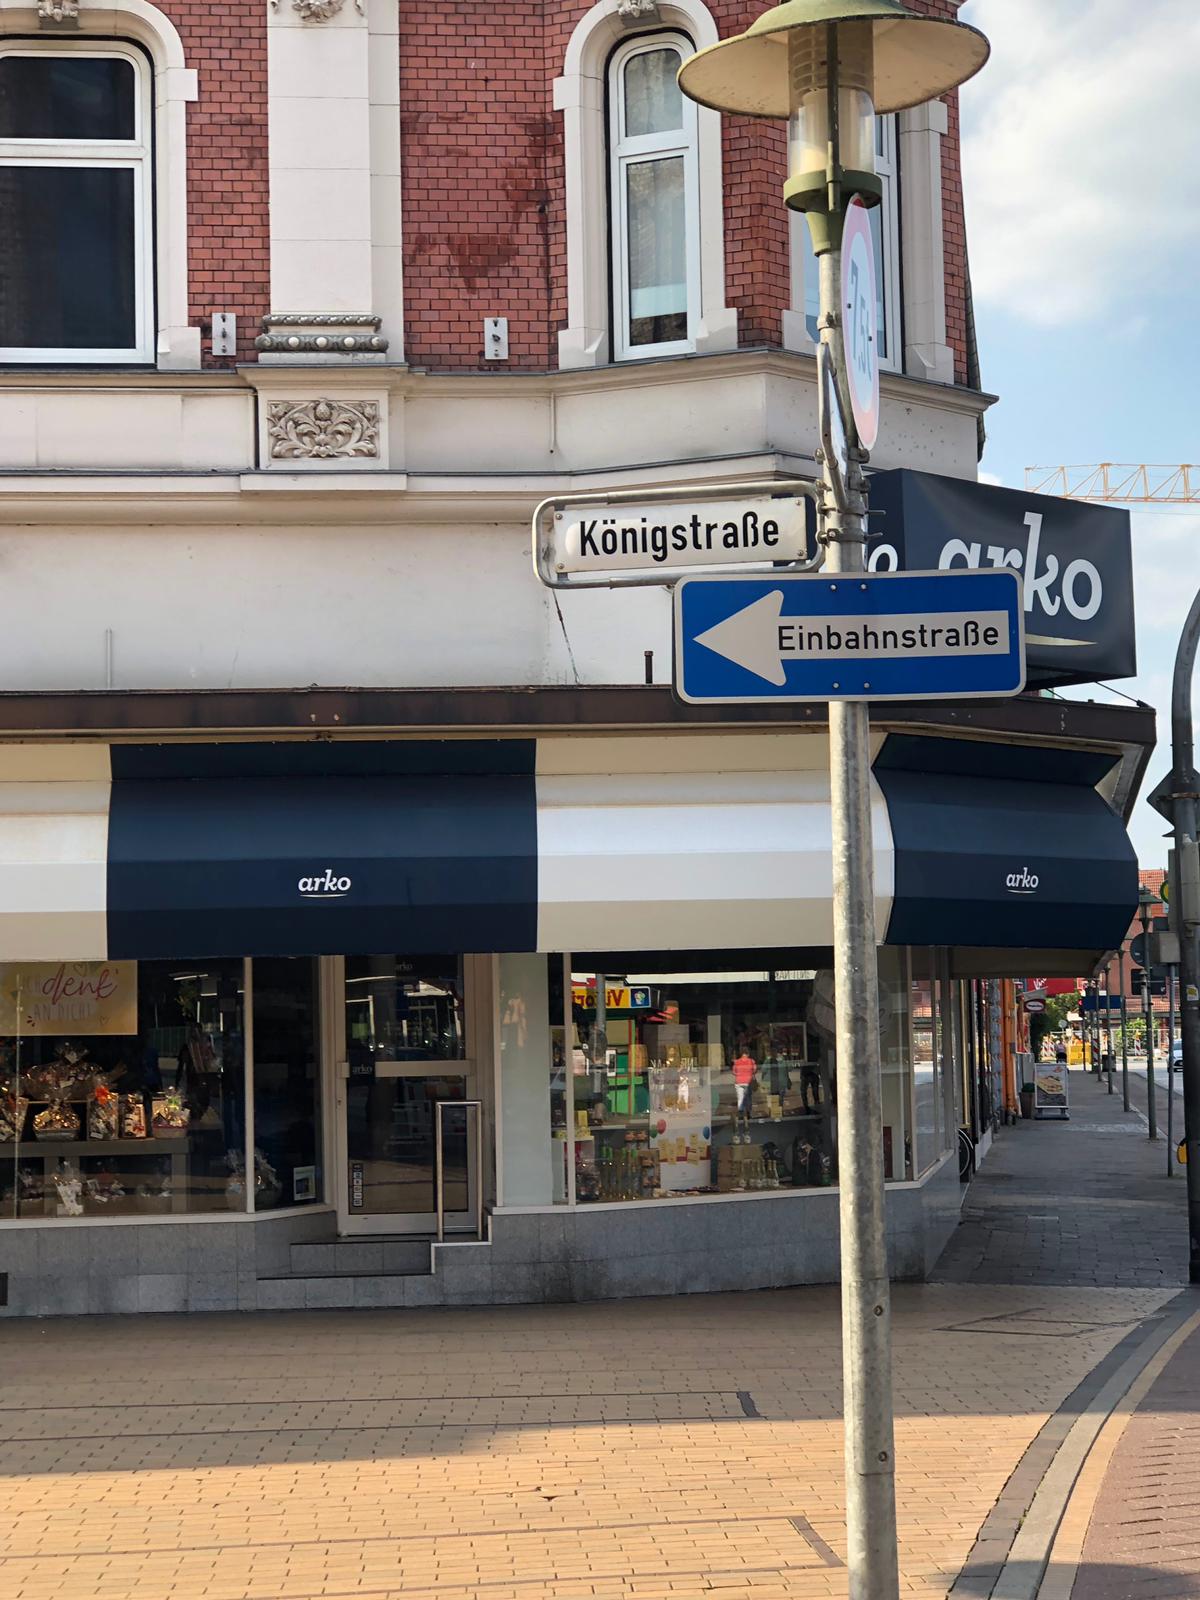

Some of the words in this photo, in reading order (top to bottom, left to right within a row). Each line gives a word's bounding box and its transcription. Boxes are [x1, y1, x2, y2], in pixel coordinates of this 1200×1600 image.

[579, 511, 780, 562] Königstraße
[778, 620, 999, 651] Einbahnstraße
[297, 868, 352, 892] arko
[1006, 866, 1039, 888] arko
